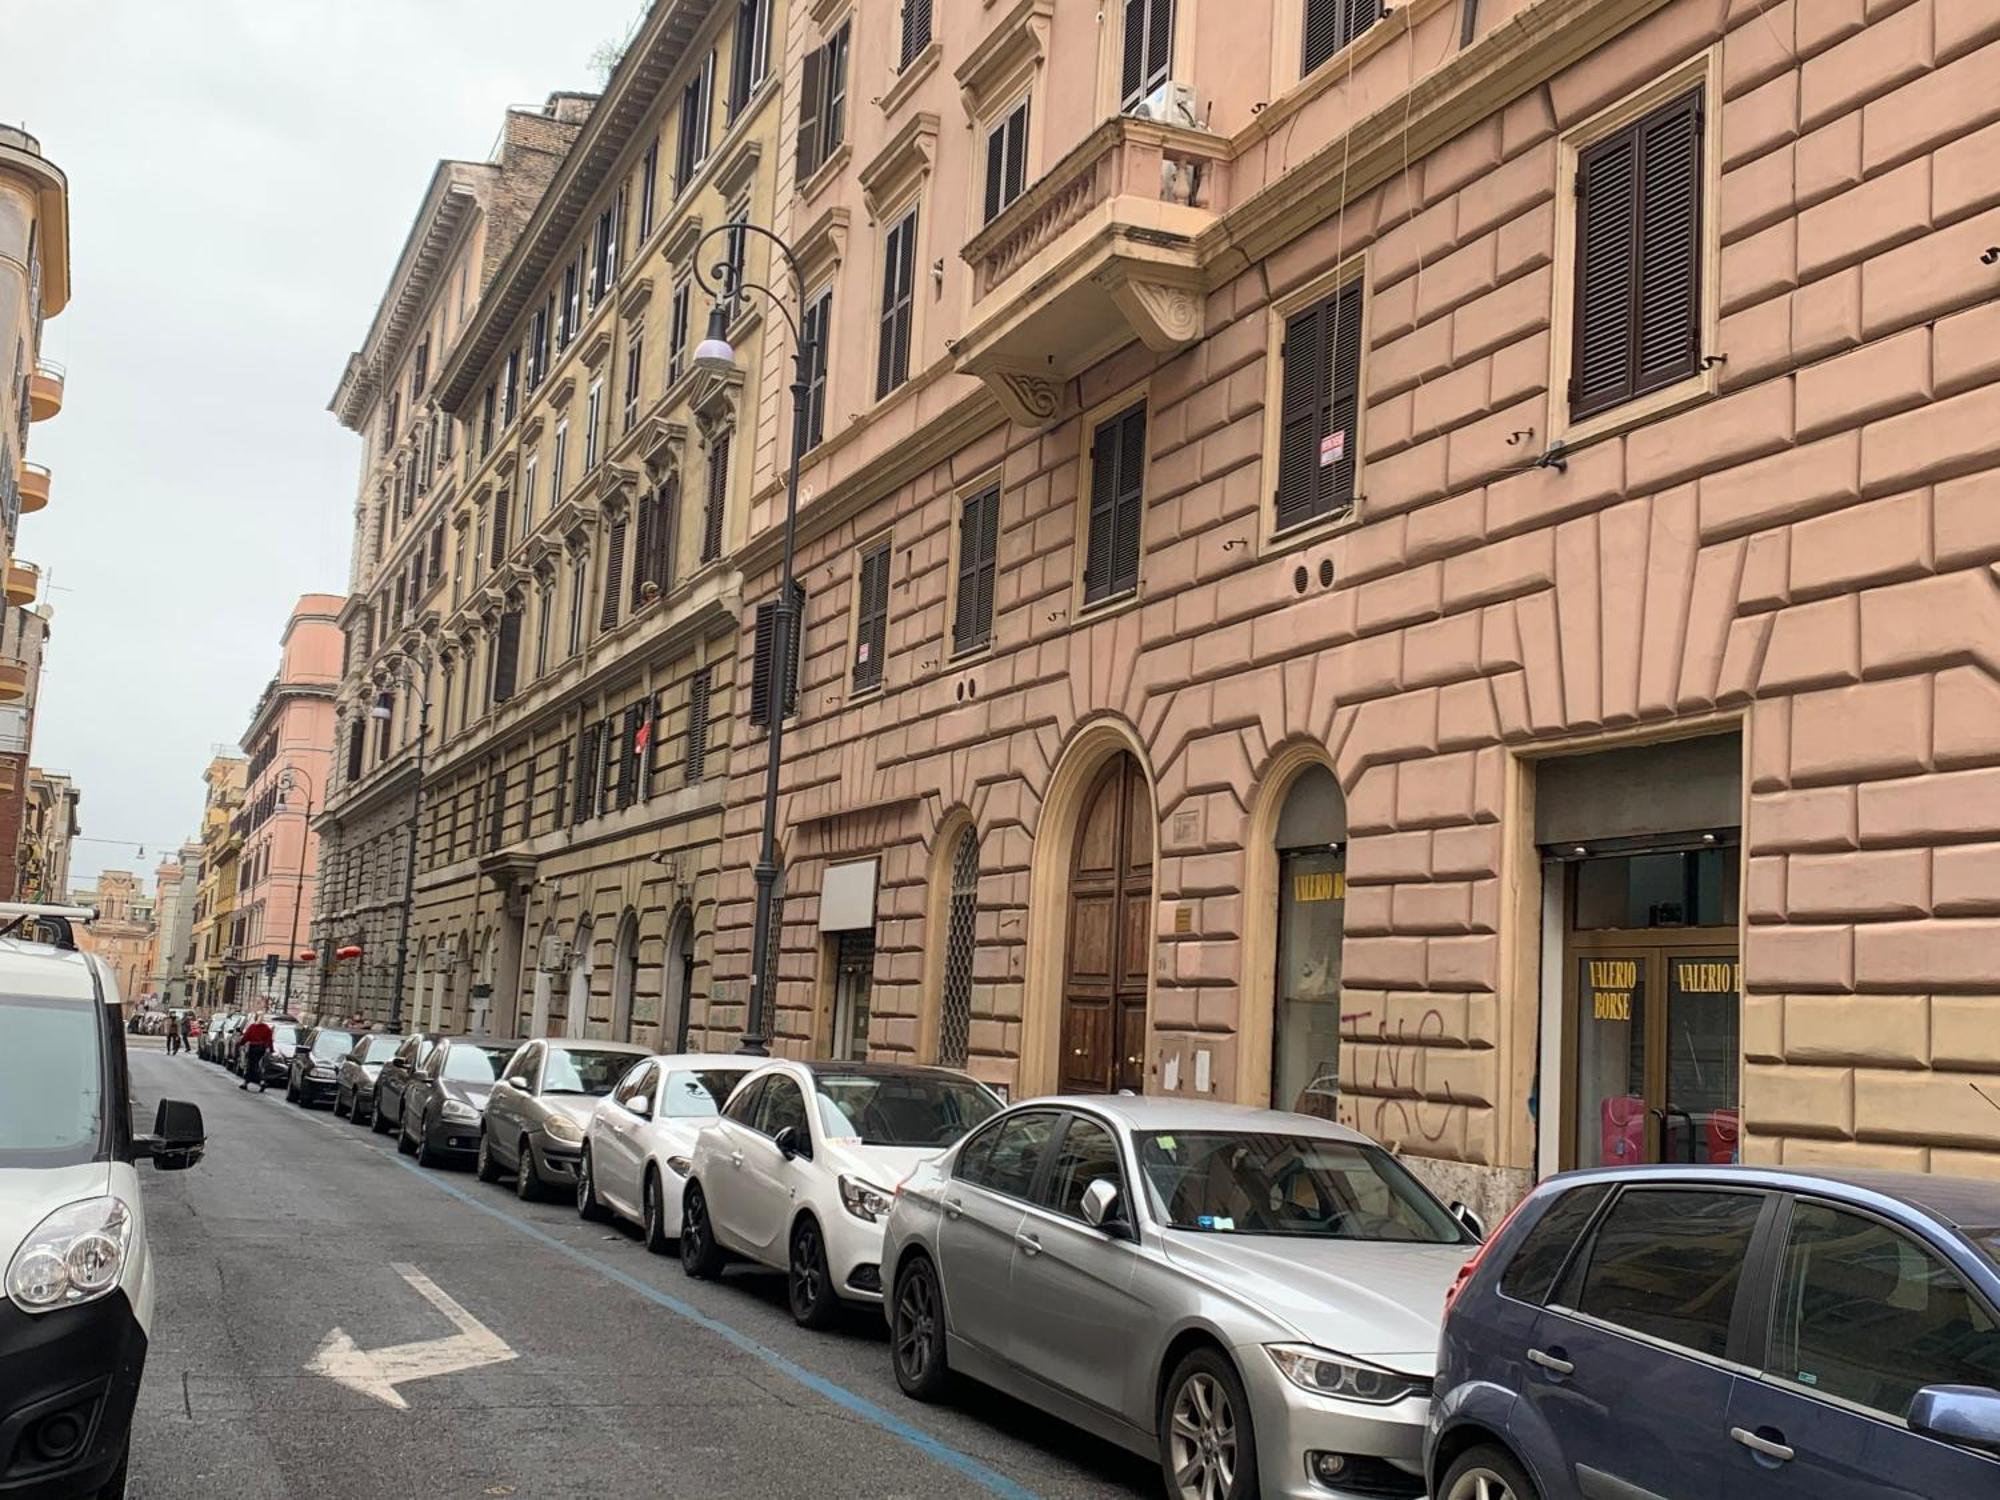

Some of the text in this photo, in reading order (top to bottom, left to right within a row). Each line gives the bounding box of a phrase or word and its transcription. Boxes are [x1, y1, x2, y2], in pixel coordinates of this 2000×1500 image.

[1294, 872, 1334, 902] VALERIO
[1589, 960, 1637, 989] VALERIO
[1678, 963, 1731, 993] VALERIO
[1594, 991, 1631, 1020] BORSE
